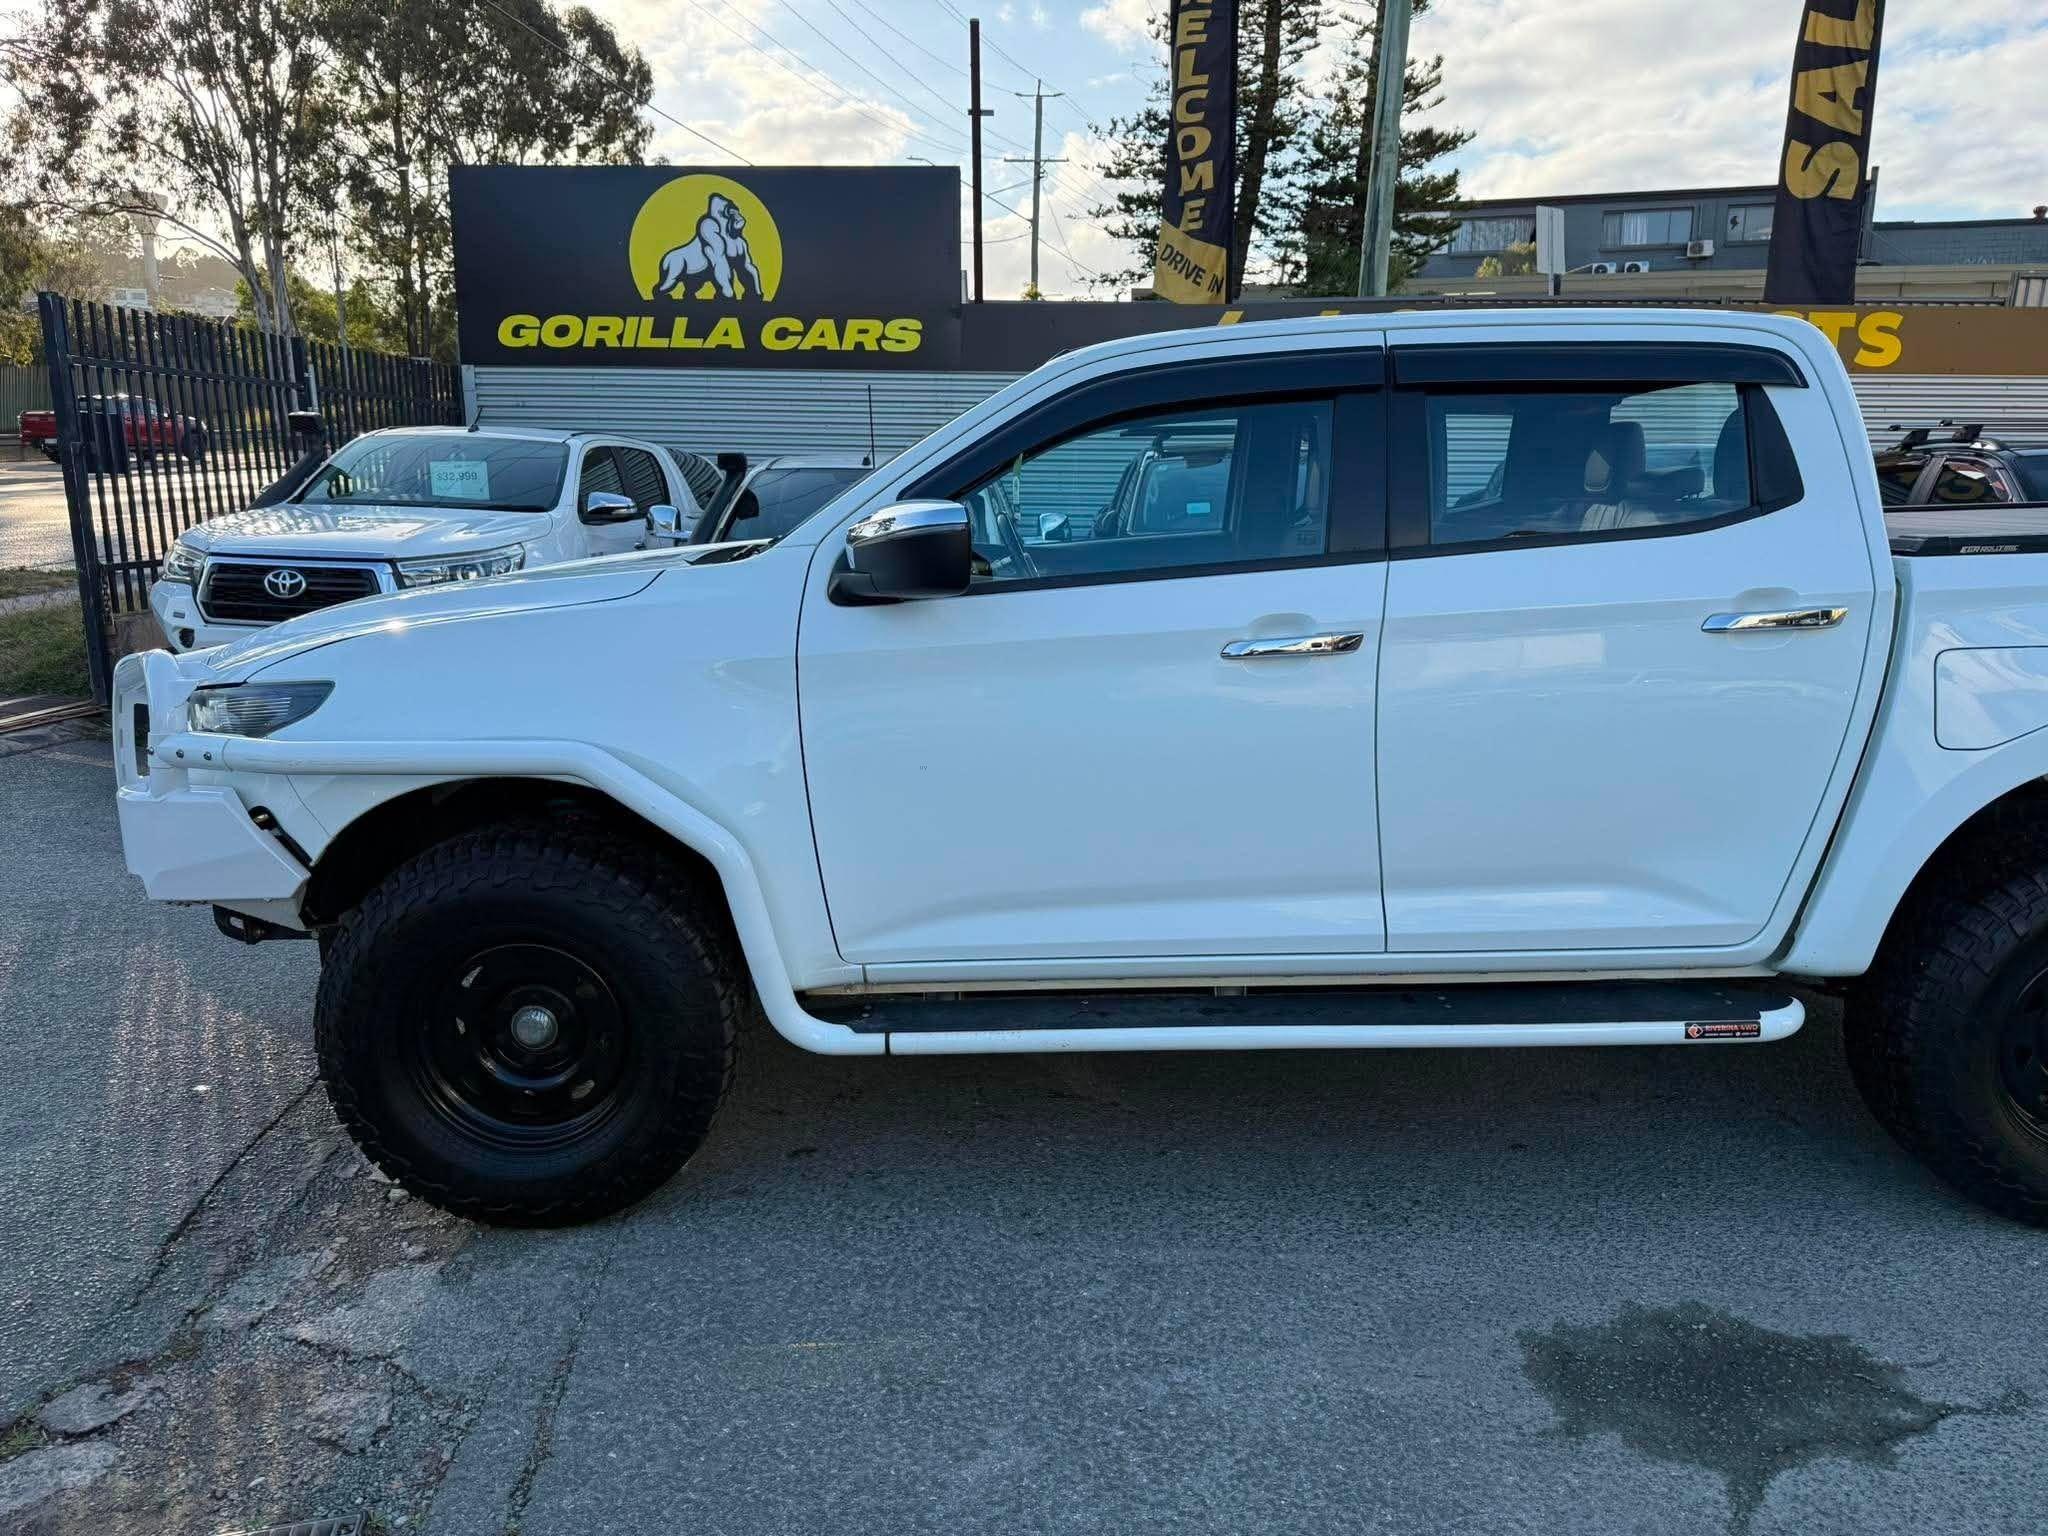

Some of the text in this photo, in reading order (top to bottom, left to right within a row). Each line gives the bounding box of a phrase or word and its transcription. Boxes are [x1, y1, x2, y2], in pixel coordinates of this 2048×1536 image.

[1175, 0, 1214, 236] ELCOME
[1160, 244, 1224, 296] DRIVE IN
[497, 314, 923, 352] GORILLA CARS
